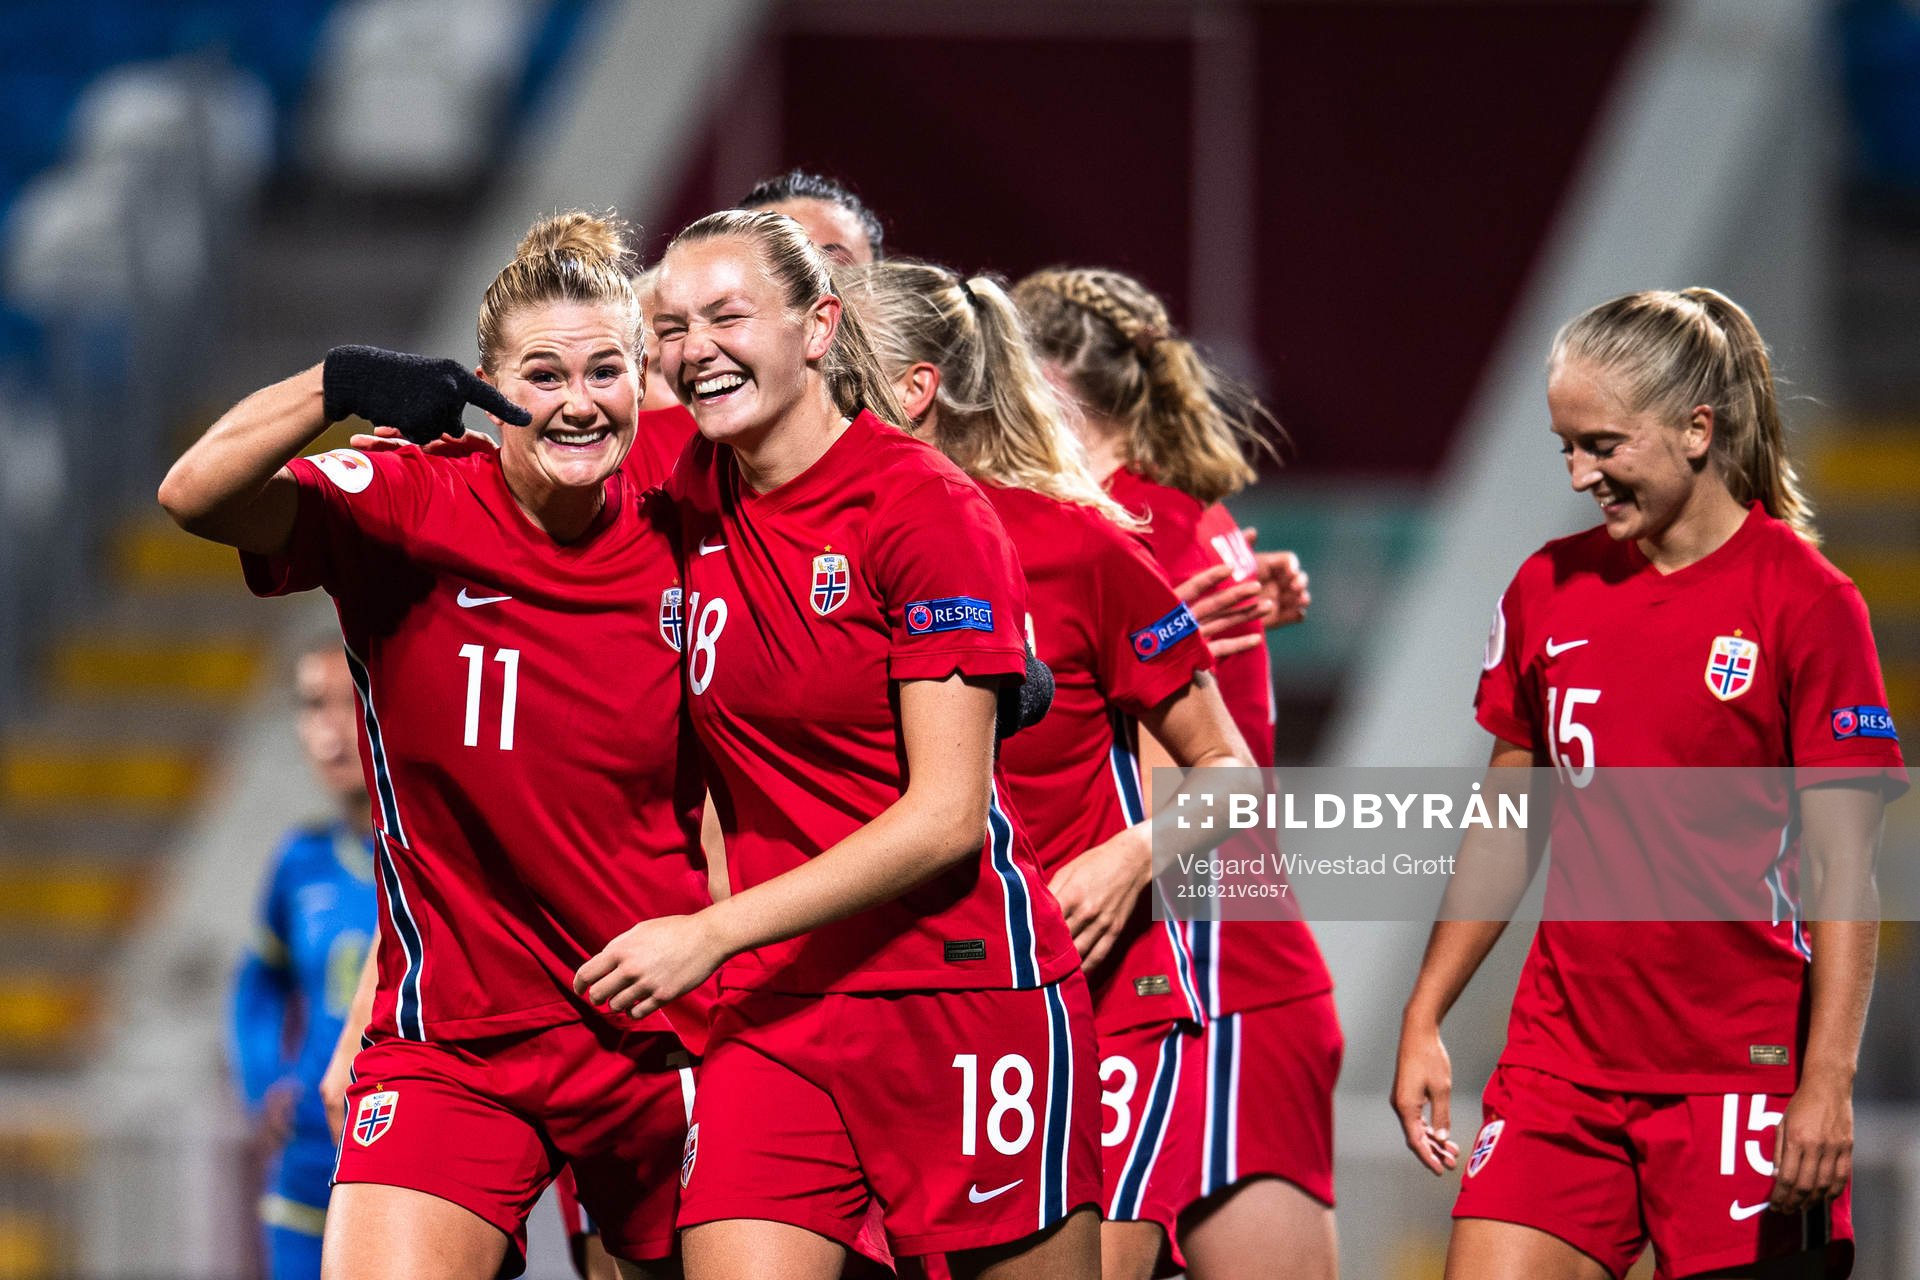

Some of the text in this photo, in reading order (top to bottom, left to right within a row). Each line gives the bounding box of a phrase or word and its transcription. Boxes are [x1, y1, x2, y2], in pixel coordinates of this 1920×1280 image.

[687, 591, 728, 695] 18
[935, 606, 992, 623] RESPECT
[458, 643, 520, 751] 11
[1547, 686, 1602, 789] 15
[952, 1053, 1035, 1156] 18
[1720, 1093, 1785, 1177] 15
